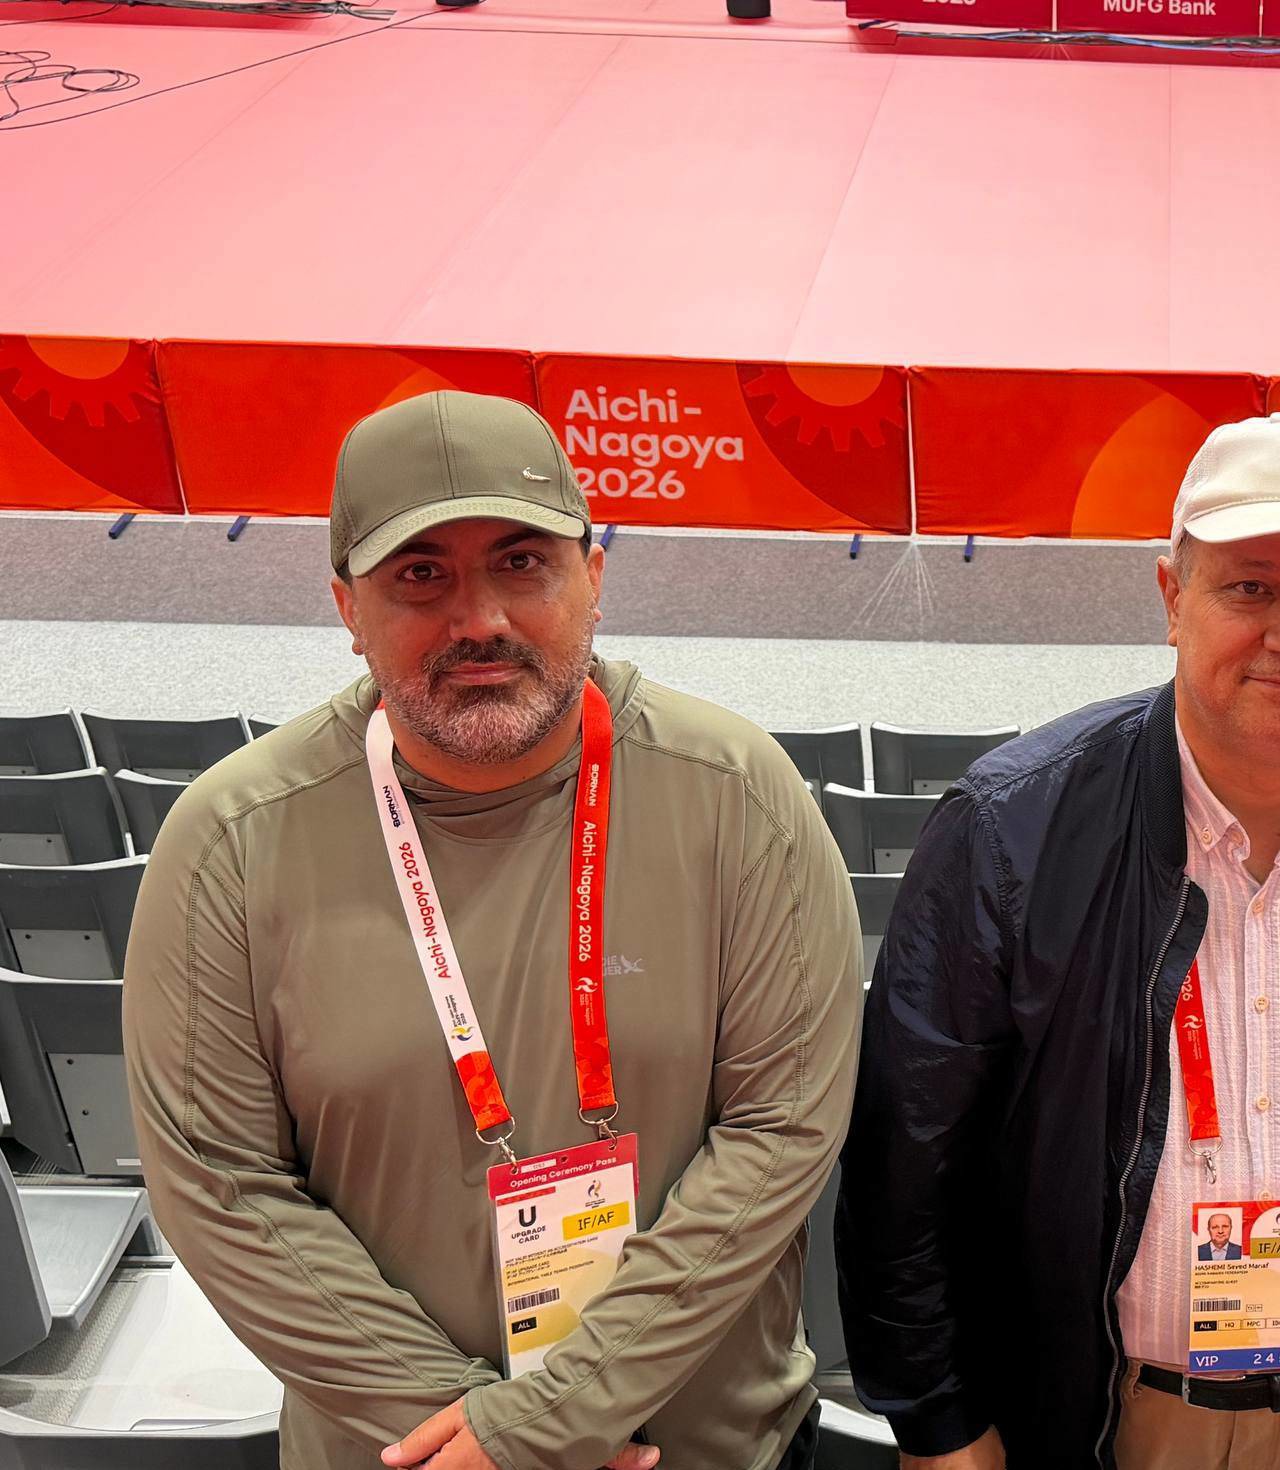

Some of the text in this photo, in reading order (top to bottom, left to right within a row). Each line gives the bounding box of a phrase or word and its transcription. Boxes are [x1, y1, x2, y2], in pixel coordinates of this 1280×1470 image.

[1103, 0, 1216, 15] MUFG Bank
[565, 385, 702, 423] Aichi-
[565, 425, 745, 470] Nagoya
[575, 467, 686, 500] 2026
[576, 820, 597, 962] Aichi-Nagoya 2026
[399, 842, 451, 979] Aichi-Nagoya 2026
[1181, 970, 1193, 1001] 026
[510, 1174, 547, 1188] Opening
[549, 1163, 593, 1179] Ceremony
[595, 1157, 616, 1167] Pass
[518, 1205, 537, 1228] U
[578, 1211, 614, 1231] IF/AF
[511, 1225, 546, 1239] UPGRADE
[518, 1234, 539, 1244] CARD
[517, 1322, 531, 1330] ALL
[1195, 1355, 1219, 1367] VIP
